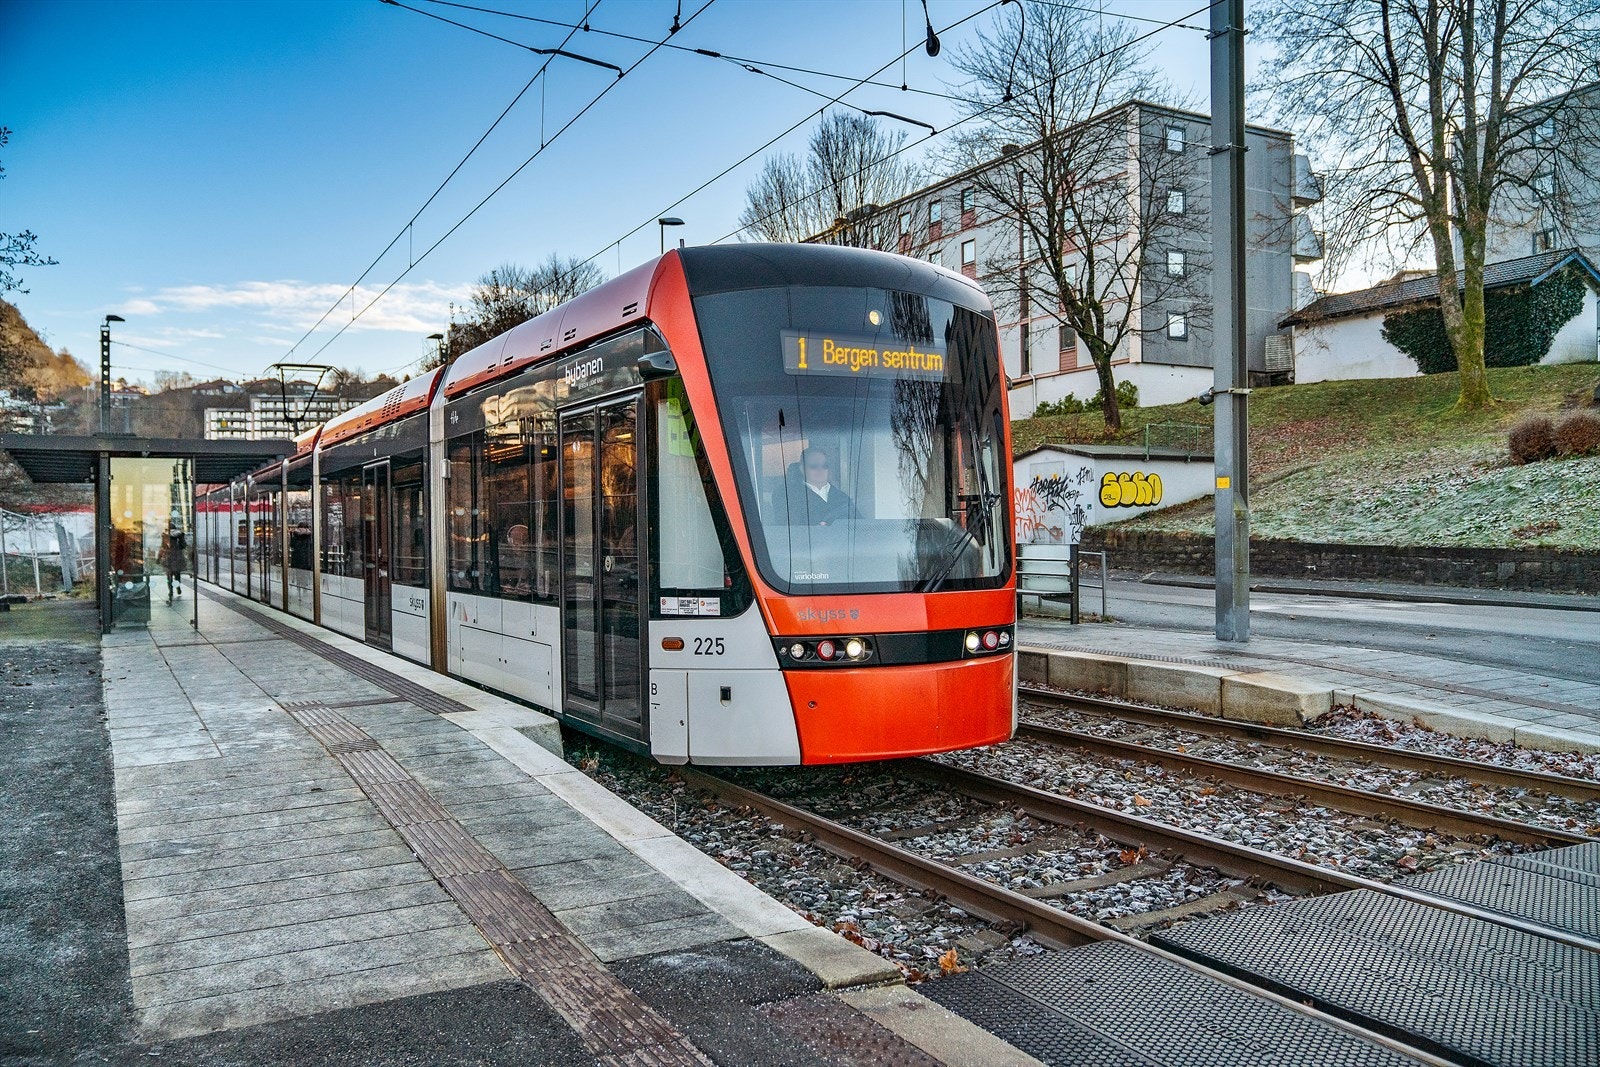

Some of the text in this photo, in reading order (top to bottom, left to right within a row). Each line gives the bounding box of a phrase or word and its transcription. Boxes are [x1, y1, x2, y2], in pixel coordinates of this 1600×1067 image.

[798, 337, 943, 371] 1 Bergen sentrum
[565, 357, 603, 387] bybanen
[794, 572, 829, 580] variobahn
[798, 607, 847, 623] skyss
[693, 637, 725, 655] 225
[651, 682, 658, 696] B
